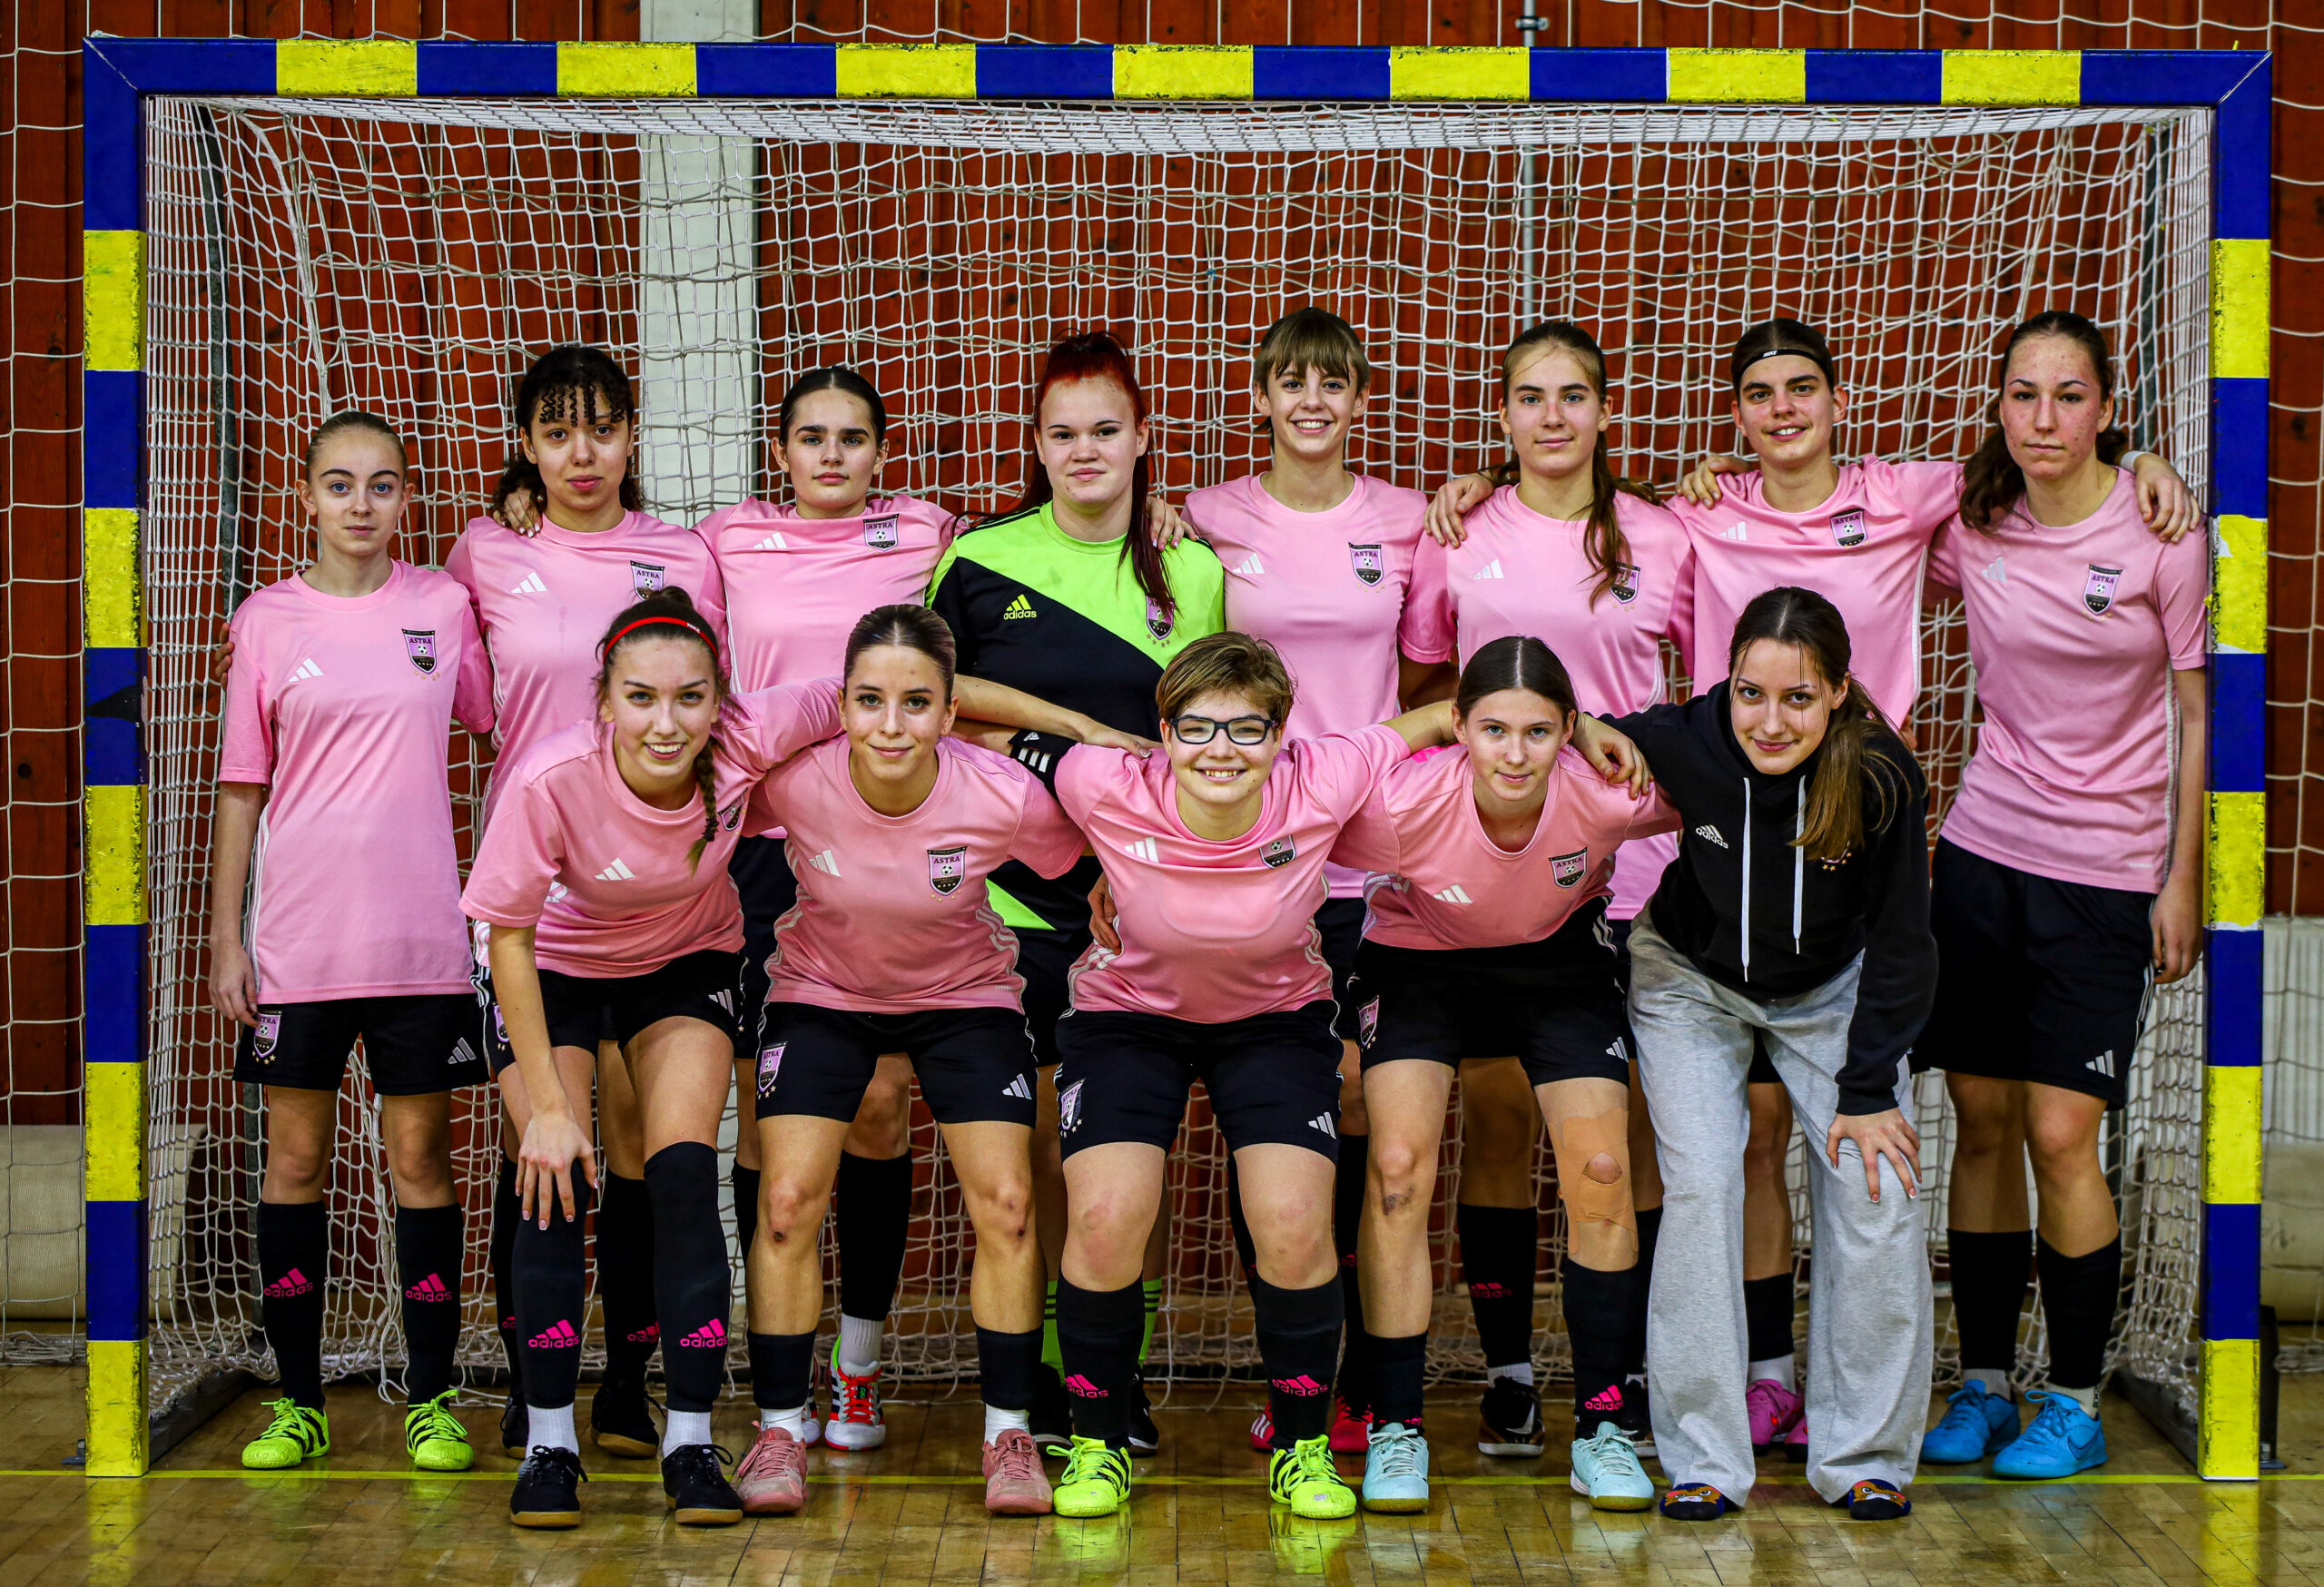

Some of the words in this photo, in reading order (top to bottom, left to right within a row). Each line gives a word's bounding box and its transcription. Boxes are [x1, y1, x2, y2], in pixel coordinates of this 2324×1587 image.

[1834, 514, 1860, 525] ASTRA
[636, 570, 660, 579] ASTRA
[2091, 574, 2114, 584] ASTRA
[1003, 609, 1037, 621] adidas
[1695, 826, 1728, 850] adidas
[933, 855, 960, 864] ASTRA
[1556, 856, 1583, 868] ASTRA
[263, 1282, 313, 1297] adidas
[405, 1290, 452, 1302] adidas
[527, 1336, 579, 1348] adidas
[679, 1336, 728, 1348] adidas
[1066, 1383, 1108, 1398] didas
[1272, 1379, 1328, 1397] adidas
